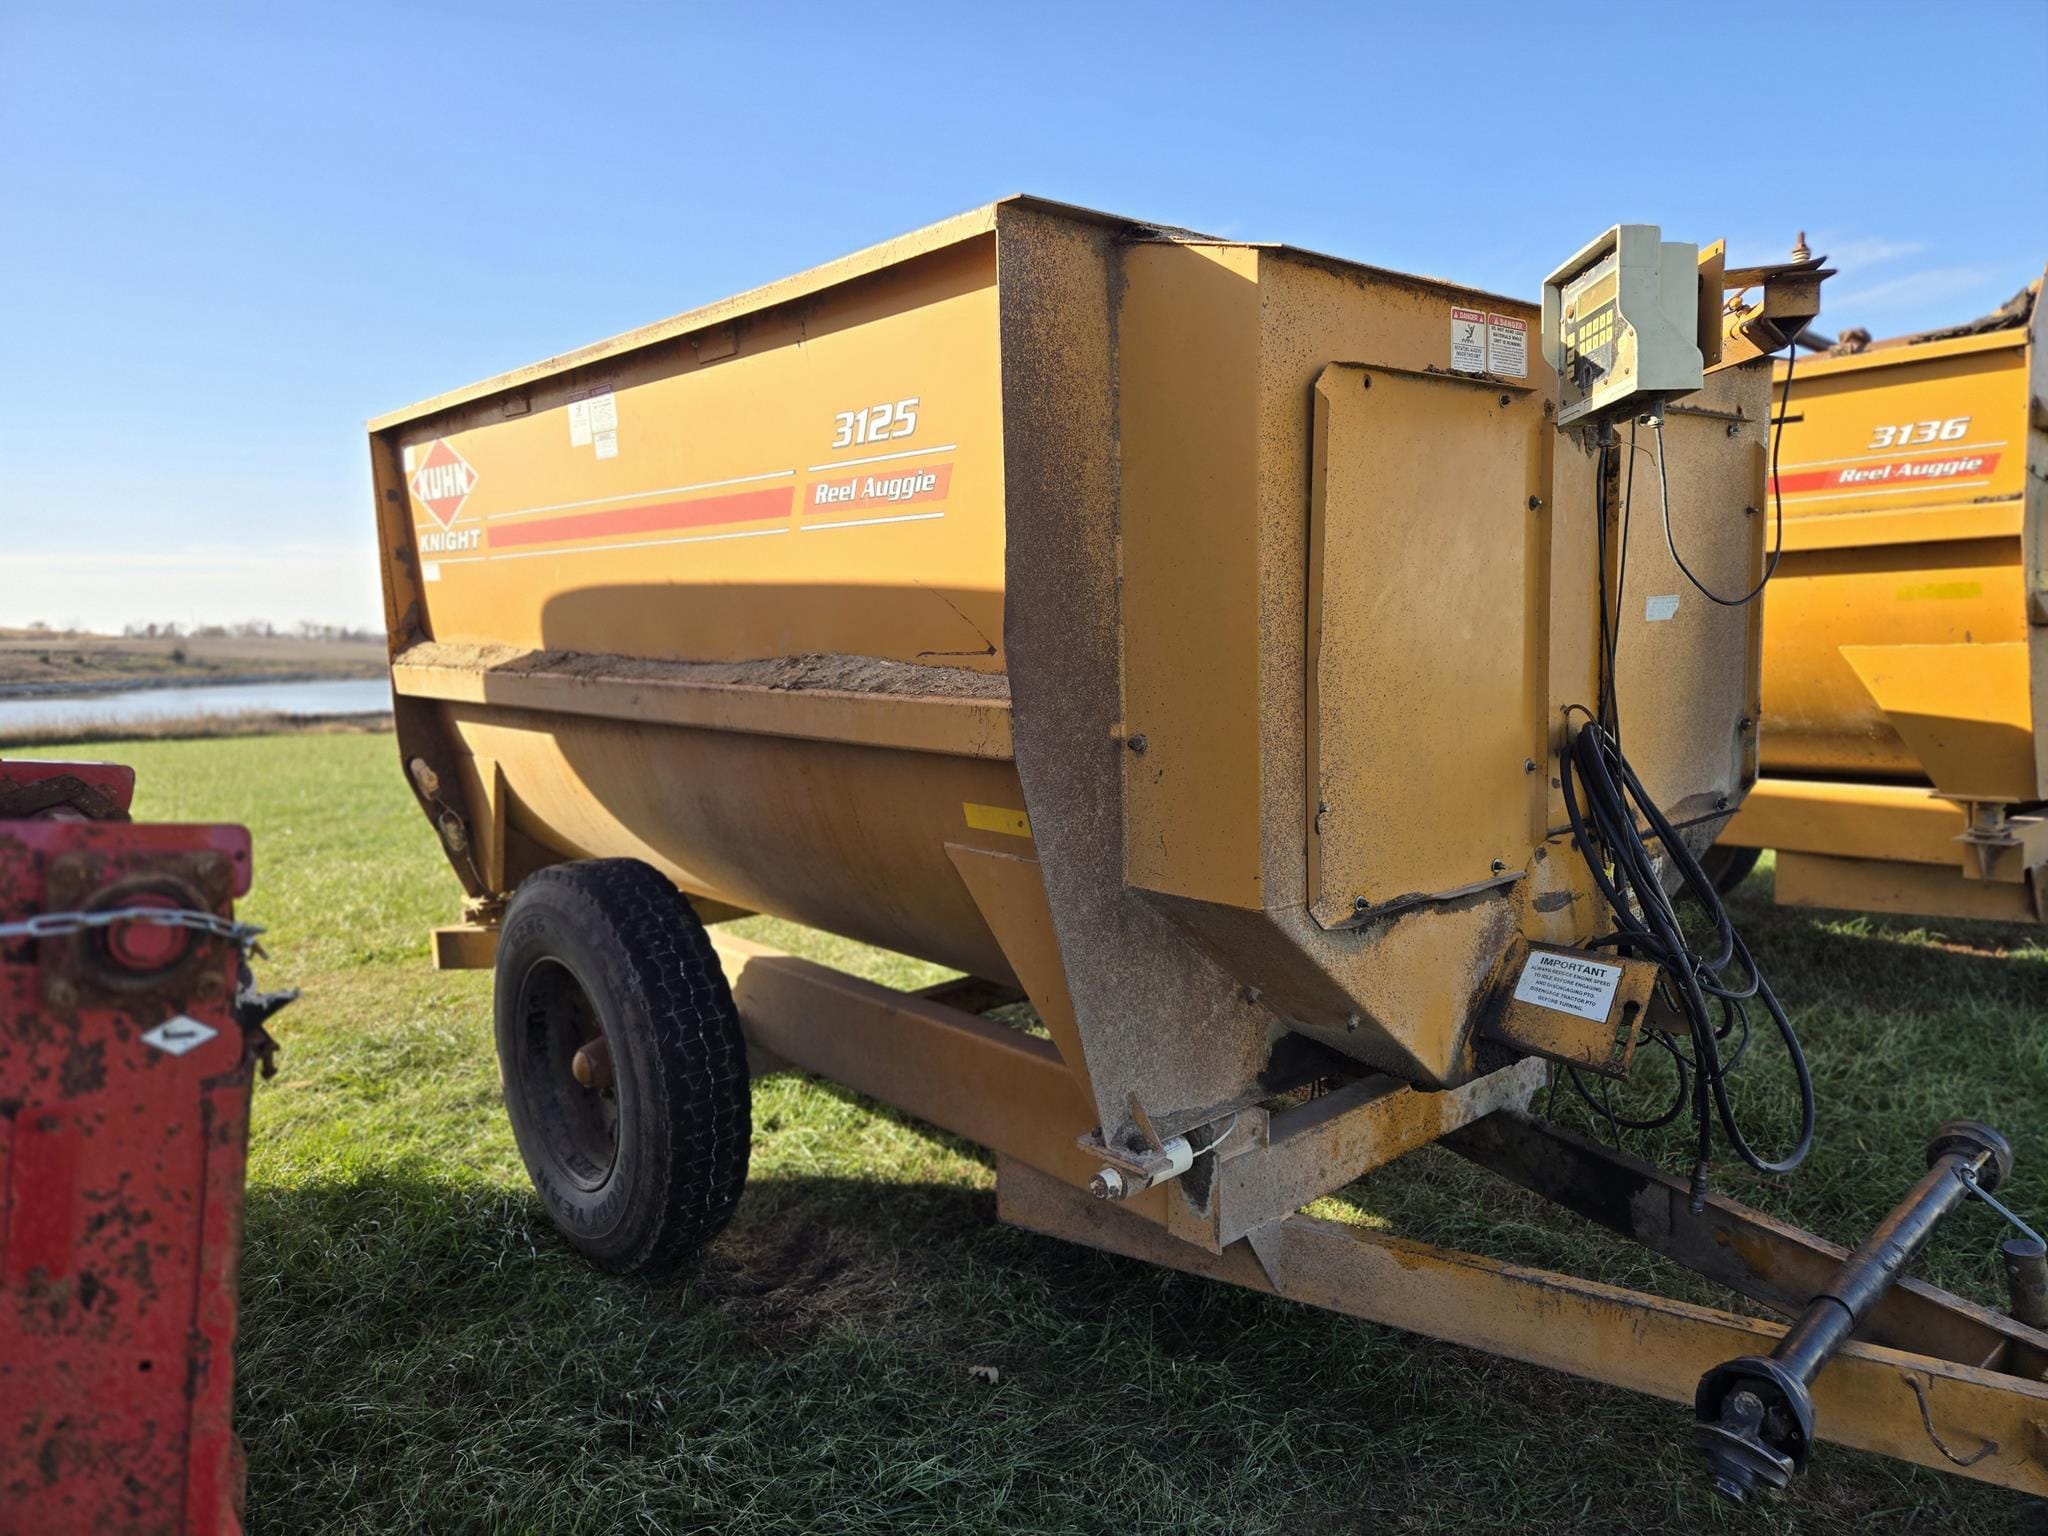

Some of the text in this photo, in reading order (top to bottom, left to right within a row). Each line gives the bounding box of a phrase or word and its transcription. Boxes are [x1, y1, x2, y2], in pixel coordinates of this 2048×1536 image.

[1500, 318, 1523, 330] DANGER
[832, 397, 920, 449] 3125
[1868, 416, 1972, 449] 3136
[418, 460, 468, 502] KUHN
[1838, 456, 1983, 484] Reel Auggie
[815, 470, 937, 505] Reel Auggie
[420, 528, 481, 552] KNIGHT
[1531, 965, 1552, 973] ALWAYS
[1573, 973, 1592, 983] ENGINE
[1594, 978, 1611, 987] SPEED
[1540, 957, 1608, 978] IMPORTANT
[1554, 976, 1574, 986] BEFORE
[1574, 981, 1602, 993] ENGAGING
[1538, 996, 1558, 1005] BEFORE
[1560, 994, 1584, 1004] TRACTOR
[1584, 999, 1596, 1007] PTO
